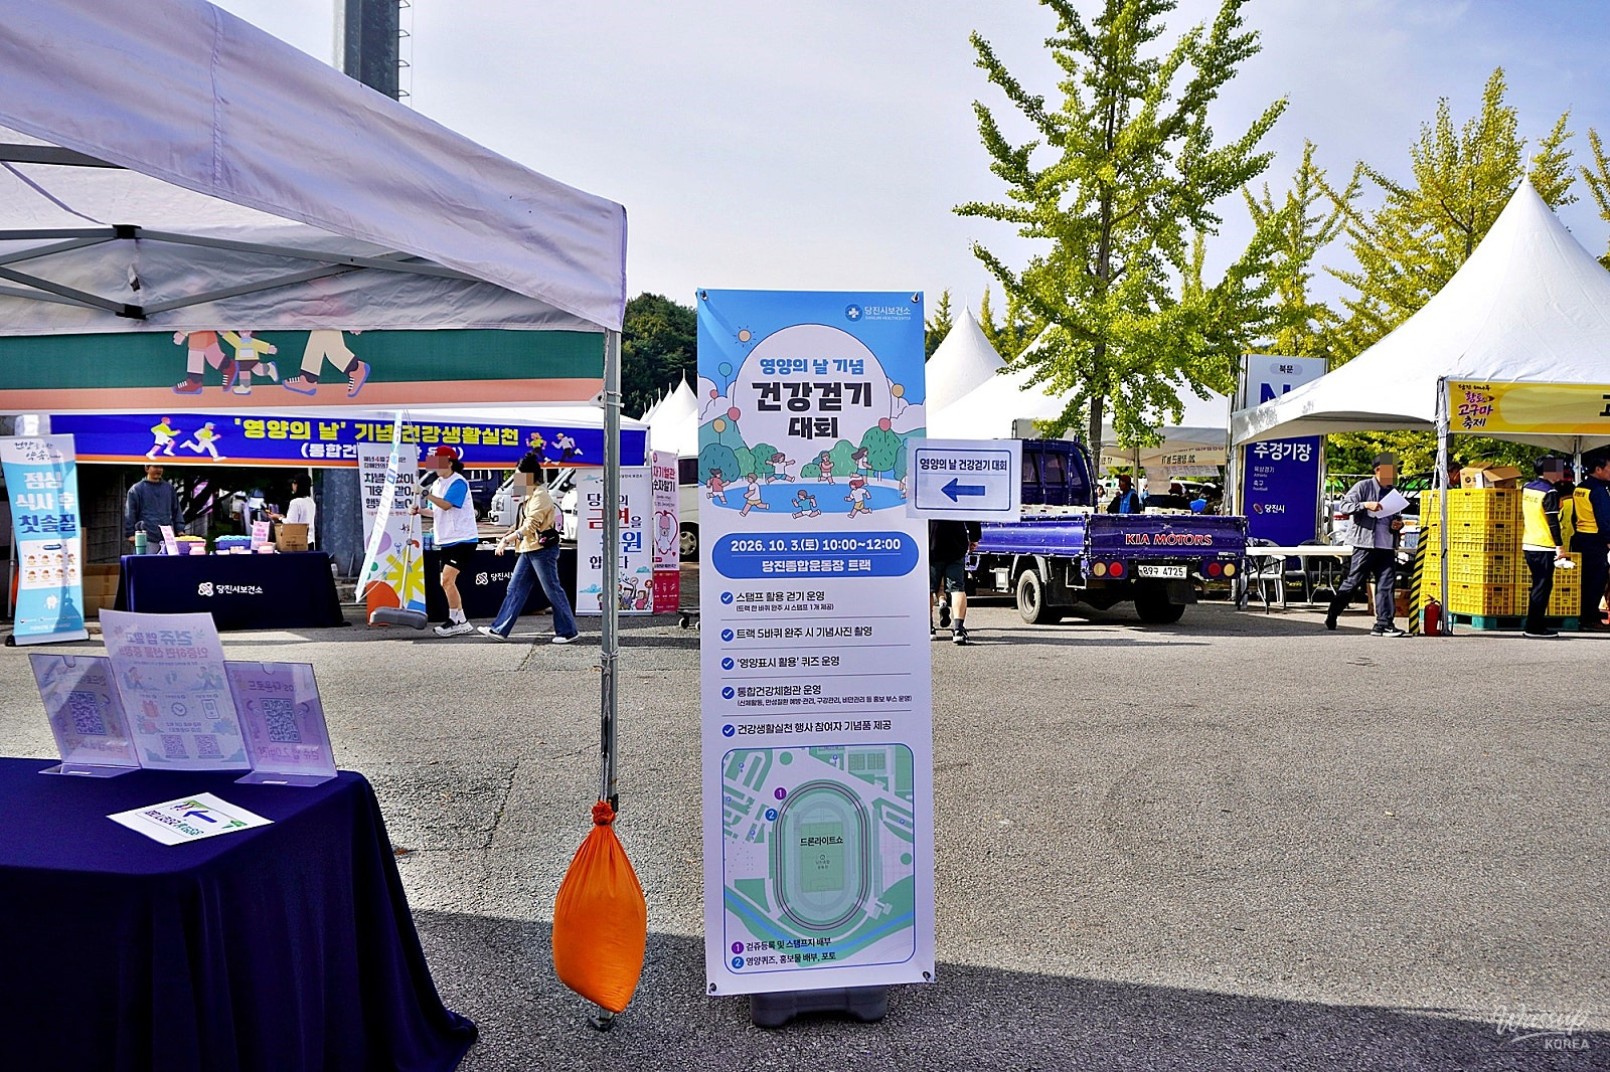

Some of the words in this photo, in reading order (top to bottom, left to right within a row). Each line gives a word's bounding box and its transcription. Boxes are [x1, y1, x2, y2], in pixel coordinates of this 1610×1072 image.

[864, 306, 911, 316] 당진시보건소
[760, 358, 808, 375] 영양의
[812, 358, 828, 375] 날
[832, 358, 864, 374] 기념
[1279, 365, 1294, 374] 북문
[752, 382, 872, 411] 건강걷기
[1458, 404, 1494, 416] 고구마
[788, 417, 838, 440] 대회
[1462, 416, 1487, 429] 축제
[234, 418, 311, 440] '영양의
[318, 421, 347, 441] 날'
[354, 423, 394, 443] 기념
[401, 424, 519, 446] 건강생활실천
[1253, 442, 1312, 462] 주경기장
[919, 458, 946, 471] 영양의
[948, 460, 957, 471] 날
[958, 460, 991, 471] 건강걷기
[991, 460, 1007, 471] 대회
[23, 471, 62, 489] 점심
[1264, 504, 1285, 513] 당진시
[18, 513, 76, 533] 칫솔질
[731, 540, 766, 551] 2026.
[769, 540, 788, 551] 10.
[822, 538, 901, 550] 10:00~12:00
[1125, 533, 1150, 546] KIA
[1153, 533, 1213, 546] MOTORS
[762, 560, 844, 573] 당진종합운동장
[848, 559, 871, 572] 트랙
[1162, 567, 1184, 577] 4725
[215, 584, 264, 595] 당진시보건소
[736, 592, 764, 603] 스탬프
[766, 592, 784, 602] 활용
[787, 592, 805, 602] 걷기
[807, 591, 825, 601] 운영
[736, 629, 755, 639] 트랙
[758, 629, 783, 639] 5바퀴
[785, 628, 803, 638] 완주
[805, 628, 814, 637] 시
[816, 627, 852, 638] 기념사진
[854, 626, 872, 637] 촬영
[801, 657, 819, 667] 퀴즈
[822, 656, 840, 666] 운영
[737, 686, 801, 697] 통합건강체험관
[803, 685, 821, 695] 운영
[738, 725, 793, 735] 건강생활실천
[795, 723, 813, 733] 행사
[815, 722, 842, 732] 참여자
[844, 721, 871, 731] 기념품
[873, 720, 891, 730] 제공
[800, 836, 844, 847] 드론라이트쇼
[786, 939, 814, 949] 스탬프지
[746, 956, 778, 966] 영양퀴즈,
[780, 954, 801, 964] 홍보물
[803, 952, 820, 962] 배부,
[821, 952, 837, 961] 포토
